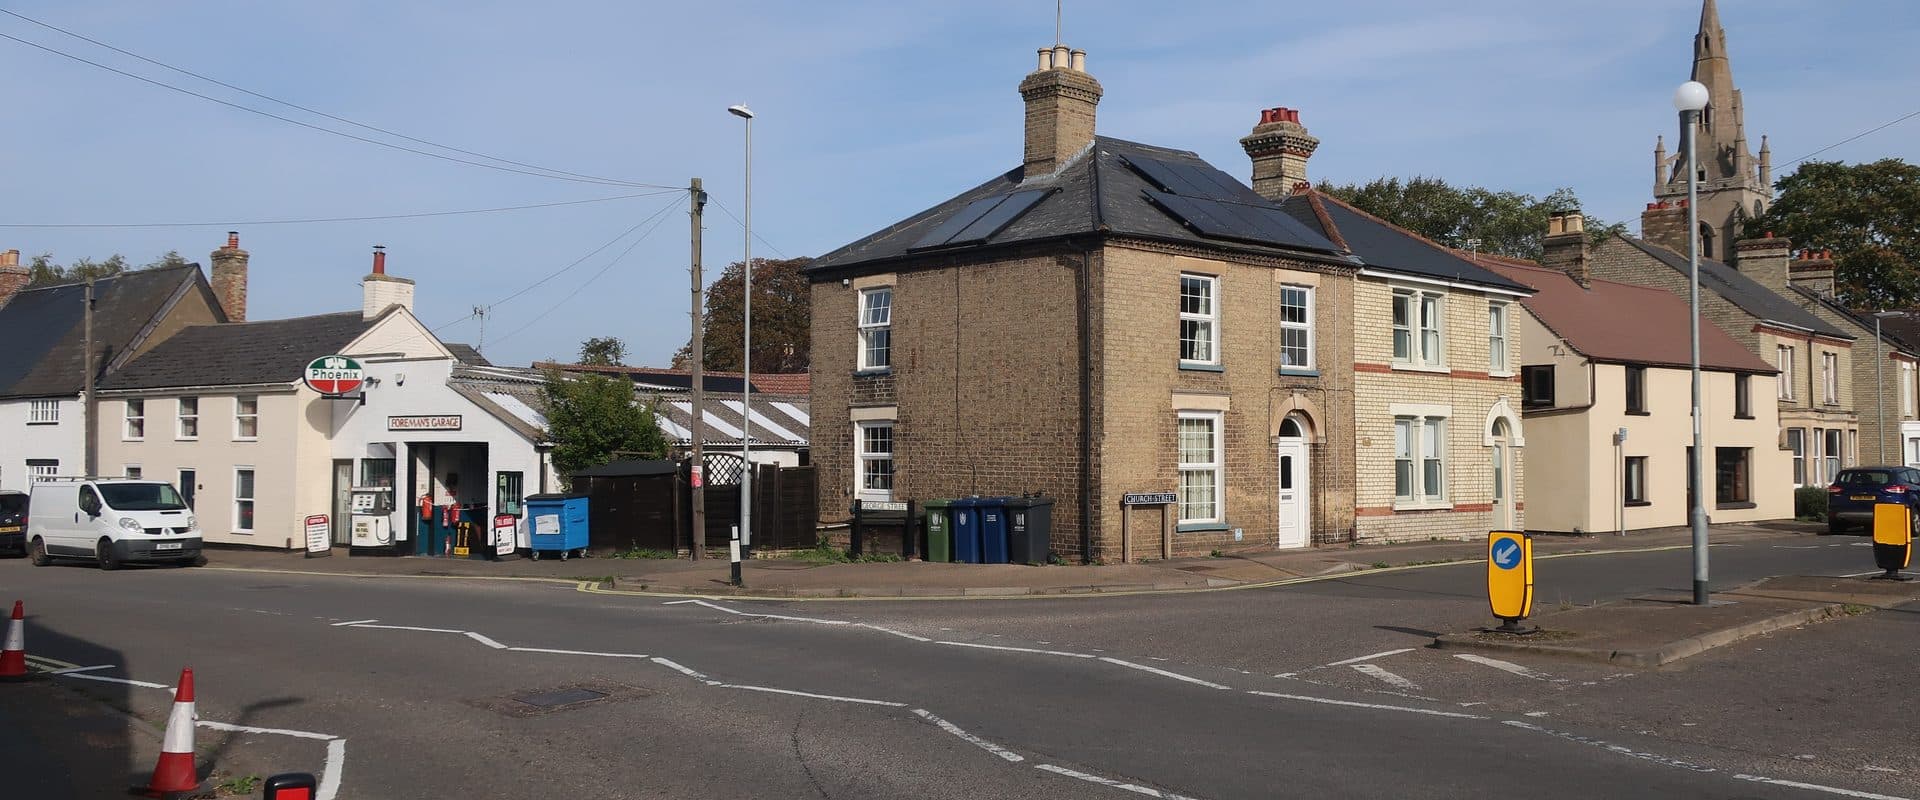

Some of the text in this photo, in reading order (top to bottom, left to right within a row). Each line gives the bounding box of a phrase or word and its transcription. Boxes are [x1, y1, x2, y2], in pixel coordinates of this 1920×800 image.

[312, 369, 358, 379] Phoenix
[391, 417, 459, 428] FOREMAN'S GARAGE
[1126, 494, 1175, 503] CHURCH STREET
